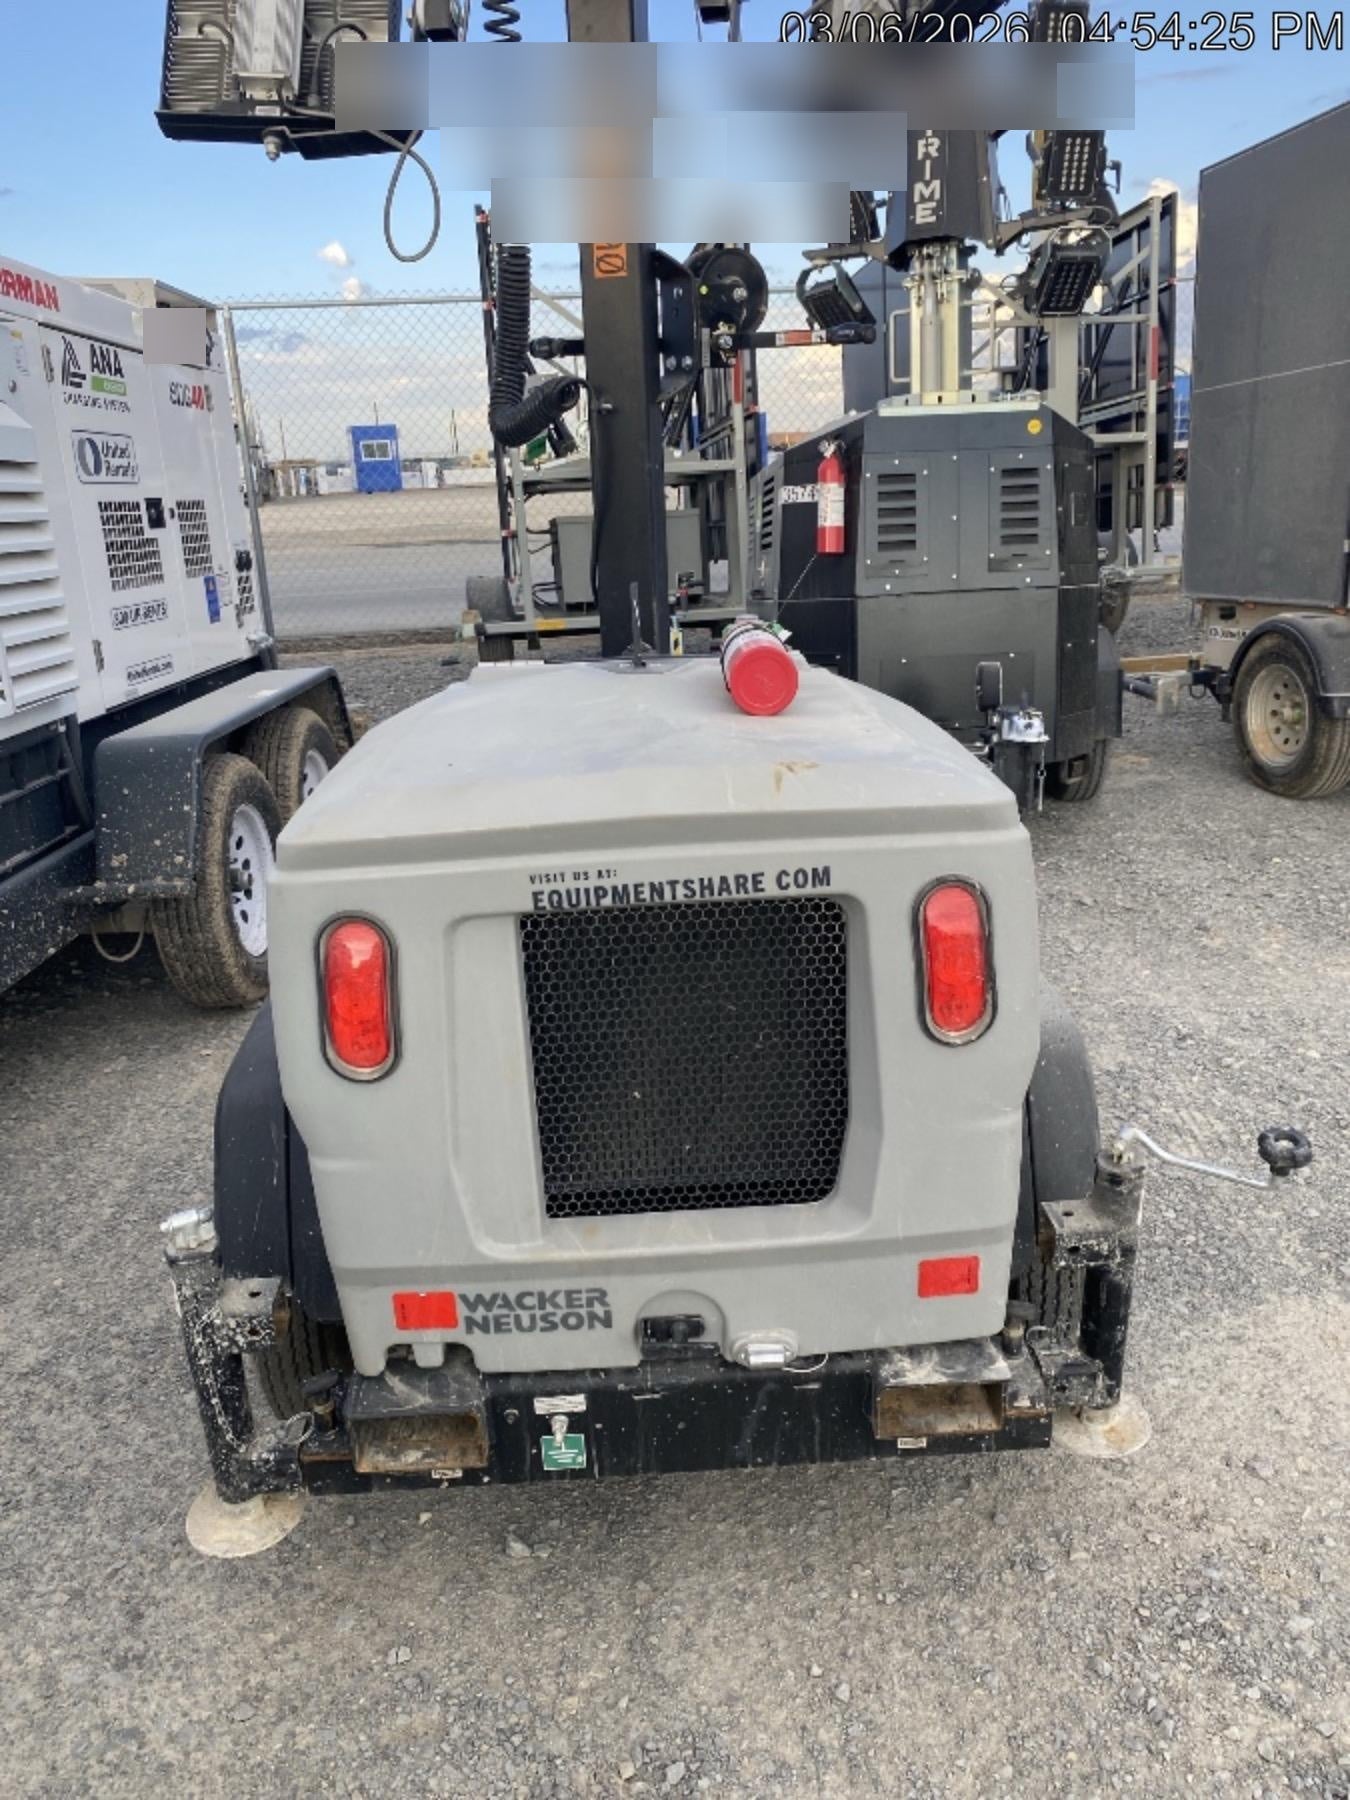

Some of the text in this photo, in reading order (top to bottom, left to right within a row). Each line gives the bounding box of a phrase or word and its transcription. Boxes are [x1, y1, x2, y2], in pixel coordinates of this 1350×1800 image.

[89, 343, 125, 378] ANA
[529, 868, 618, 885] VISIT US AT:
[458, 1287, 611, 1314] WACKER
[463, 1309, 613, 1335] NEUSON
